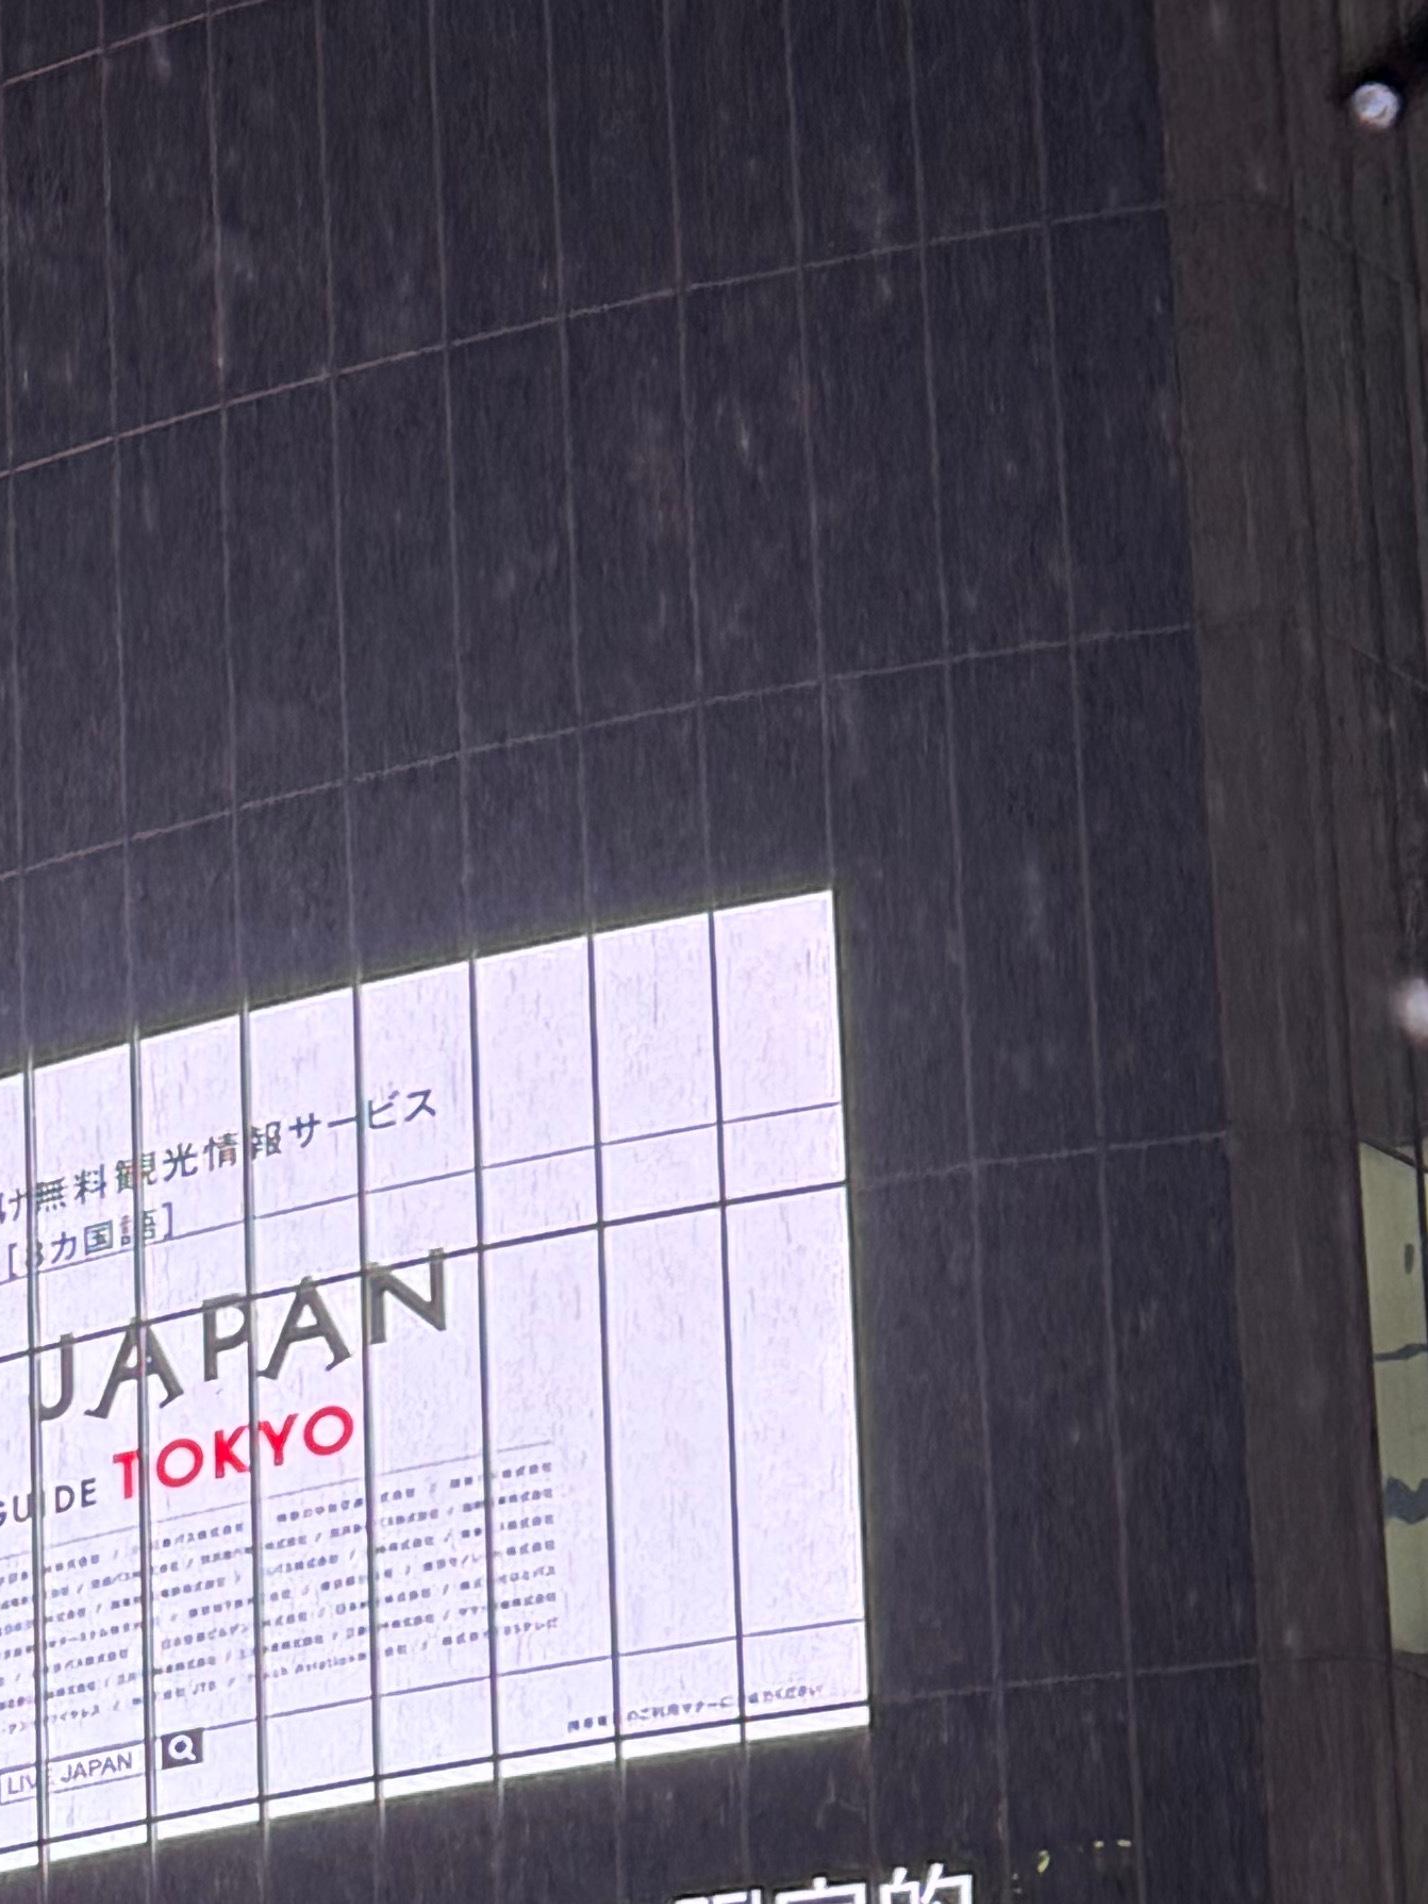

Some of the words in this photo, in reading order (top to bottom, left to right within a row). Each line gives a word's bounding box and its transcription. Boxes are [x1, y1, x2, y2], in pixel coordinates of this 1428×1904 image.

[38, 1249, 447, 1421] JAPAN
[113, 1405, 355, 1500] TOKYO
[60, 1752, 134, 1783] JAPAN
